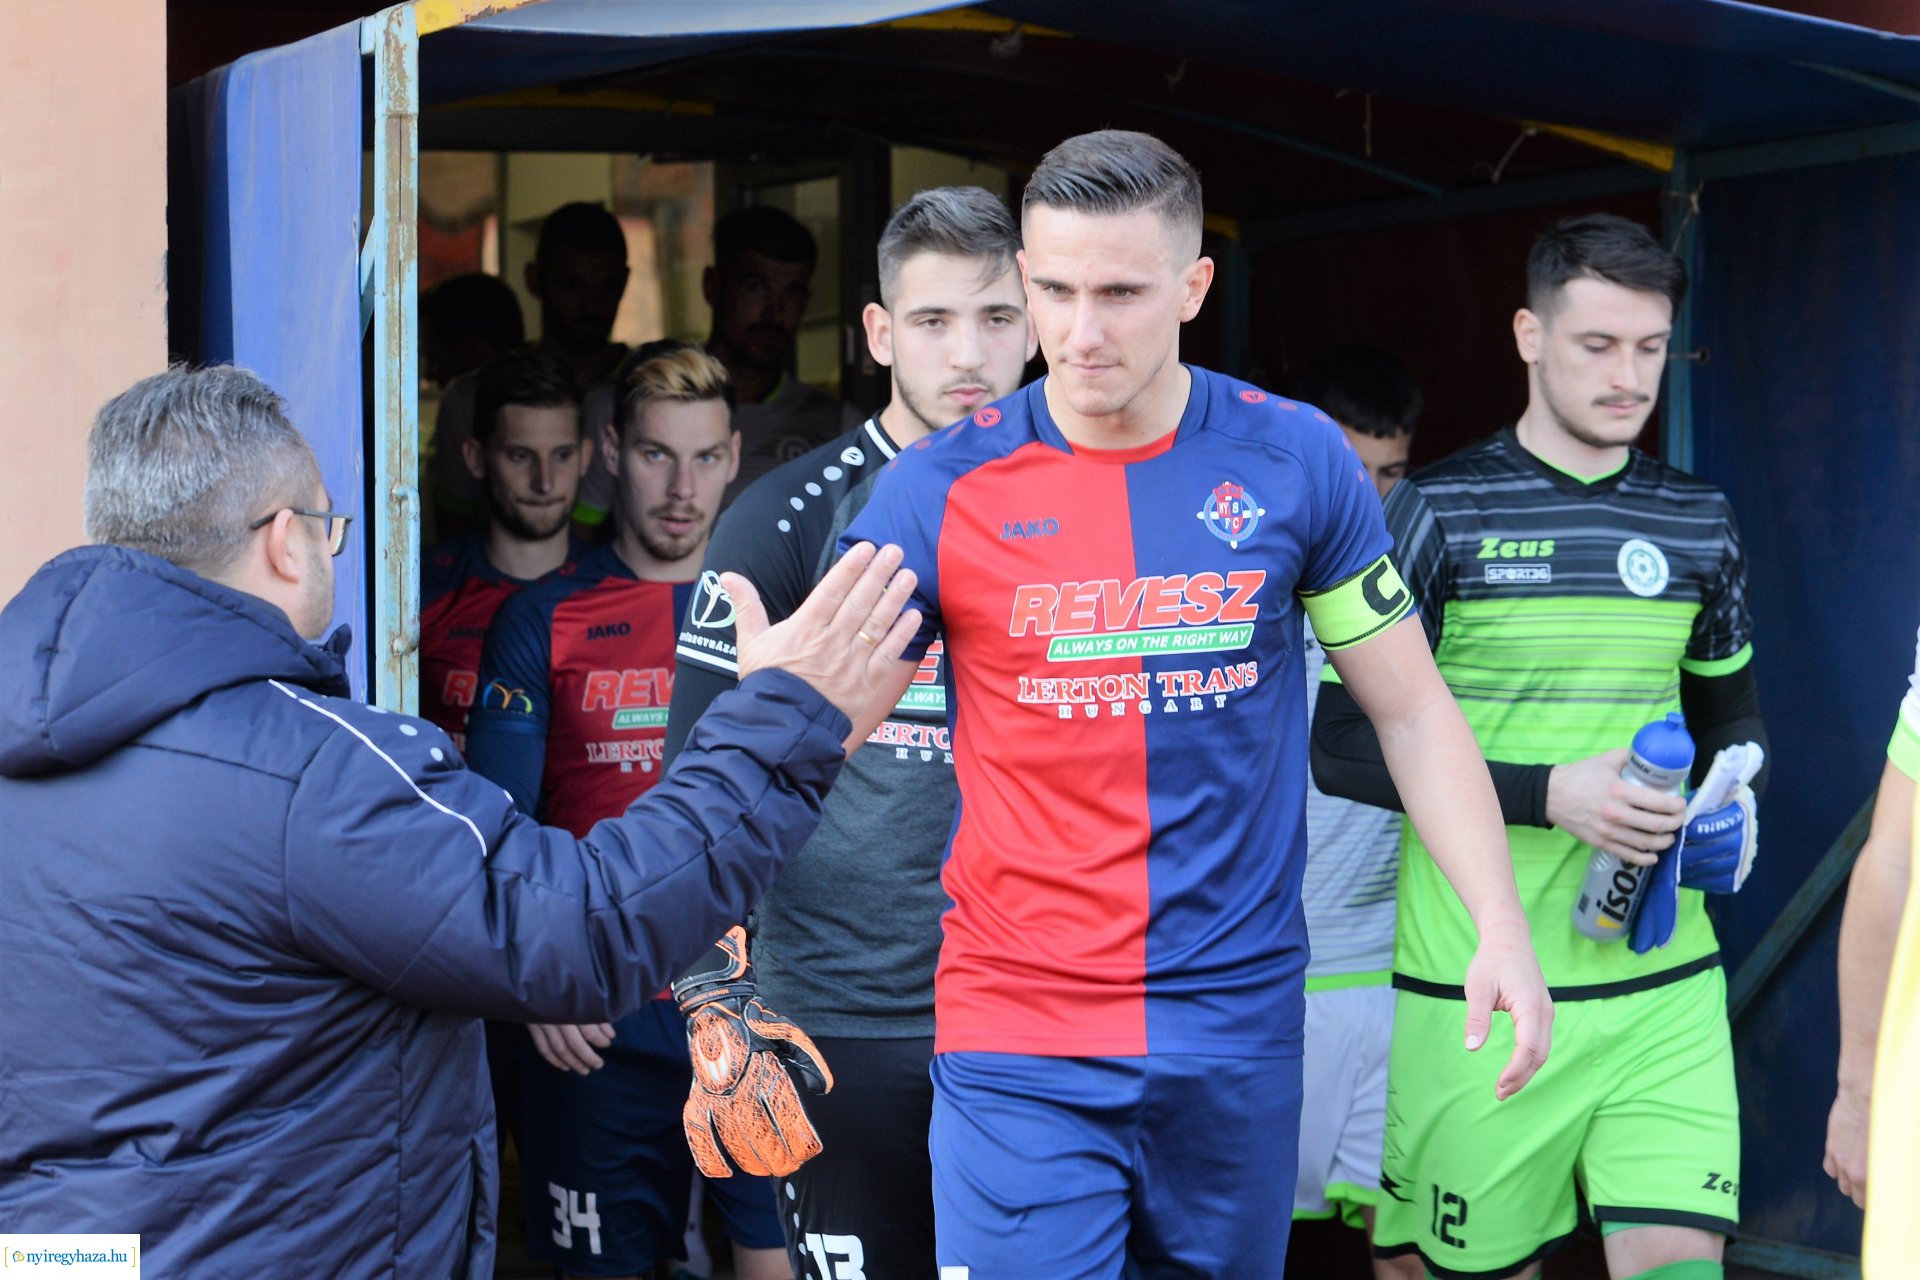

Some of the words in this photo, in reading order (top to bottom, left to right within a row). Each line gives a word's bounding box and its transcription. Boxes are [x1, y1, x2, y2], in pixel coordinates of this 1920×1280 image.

[1001, 517, 1060, 540] JAKO
[1477, 537, 1556, 559] Zeus
[1488, 567, 1548, 581] SPORT36
[1362, 560, 1406, 616] C
[1009, 570, 1267, 637] REVESZ
[586, 622, 632, 641] JAKO
[1053, 638, 1113, 656] ALWAYS
[1116, 636, 1138, 651] ON
[1141, 634, 1168, 648] THE
[1172, 631, 1217, 647] RIGHT
[1219, 629, 1249, 644] WAY
[1017, 672, 1151, 705] LERTON
[1157, 661, 1259, 698] TRANS
[618, 711, 664, 725] ALWAYS
[1058, 694, 1228, 719] HUNGARY
[549, 1182, 602, 1255] 34
[1432, 1183, 1467, 1249] 12
